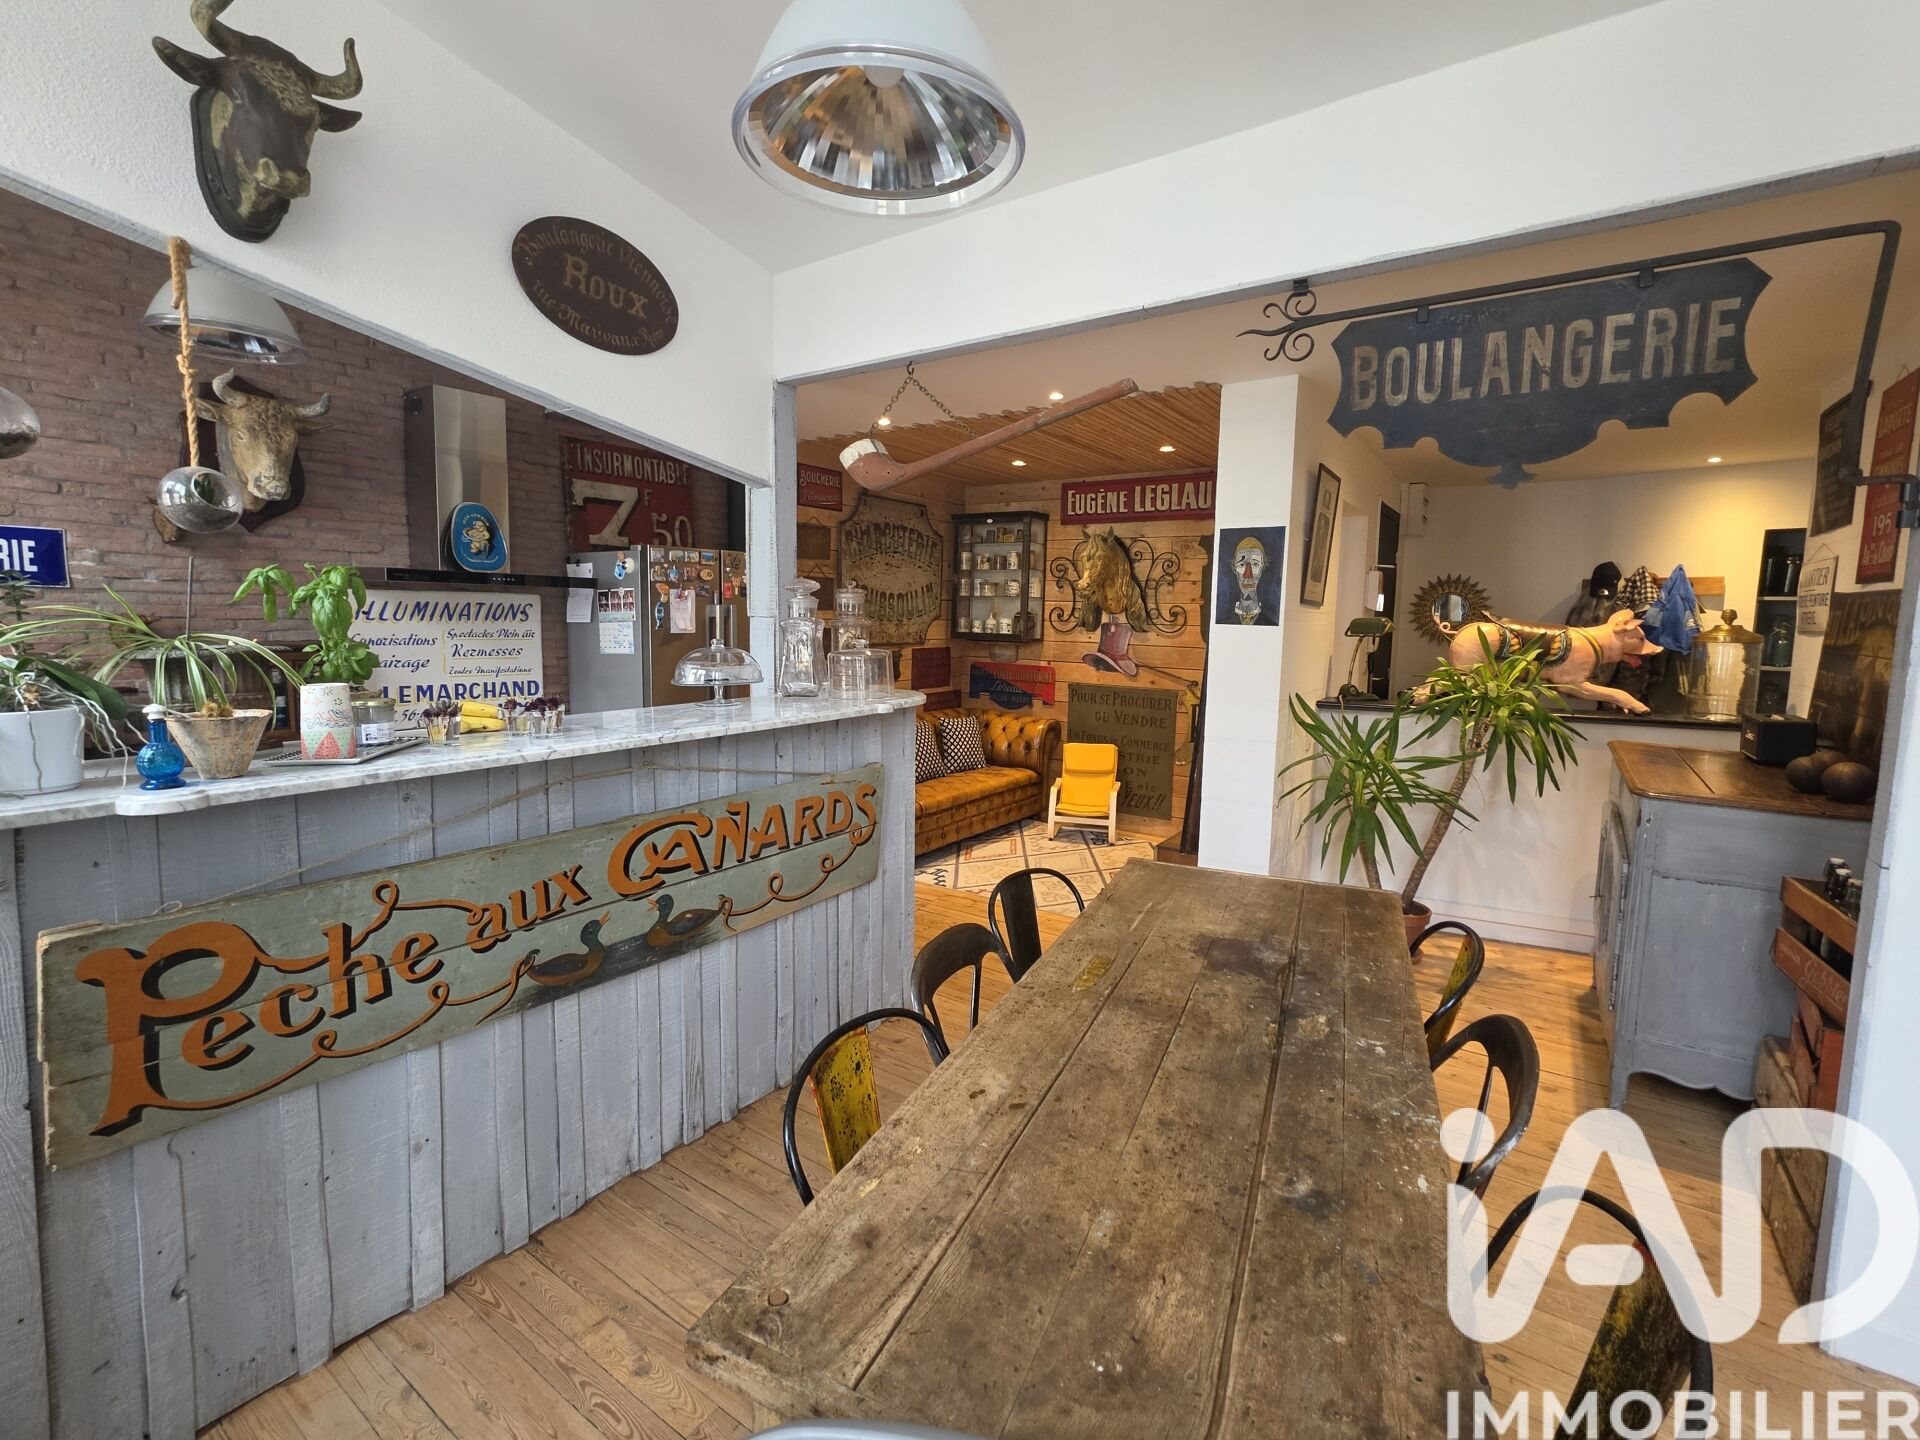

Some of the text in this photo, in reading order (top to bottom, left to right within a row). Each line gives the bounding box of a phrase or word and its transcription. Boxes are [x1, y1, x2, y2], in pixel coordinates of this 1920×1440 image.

[1351, 296, 1743, 412] BOULANGERIE
[799, 470, 841, 488] BOUCHERIE
[1134, 480, 1213, 512] LEGLAU
[571, 478, 639, 547] 7
[651, 512, 693, 547] 50
[1872, 512, 1893, 537] 195
[0, 538, 38, 572] RIE
[354, 600, 534, 622] ILLUMINATIONS
[446, 628, 495, 640] Spectacles
[495, 628, 520, 639] Plein
[379, 643, 524, 673] airage Kermesses
[1070, 688, 1172, 711] POUR SE PROCURER
[1094, 710, 1168, 729] OU VENDRE
[1120, 735, 1170, 752] COMMERCE
[1118, 751, 1161, 765] STRIE
[466, 864, 594, 954] aux
